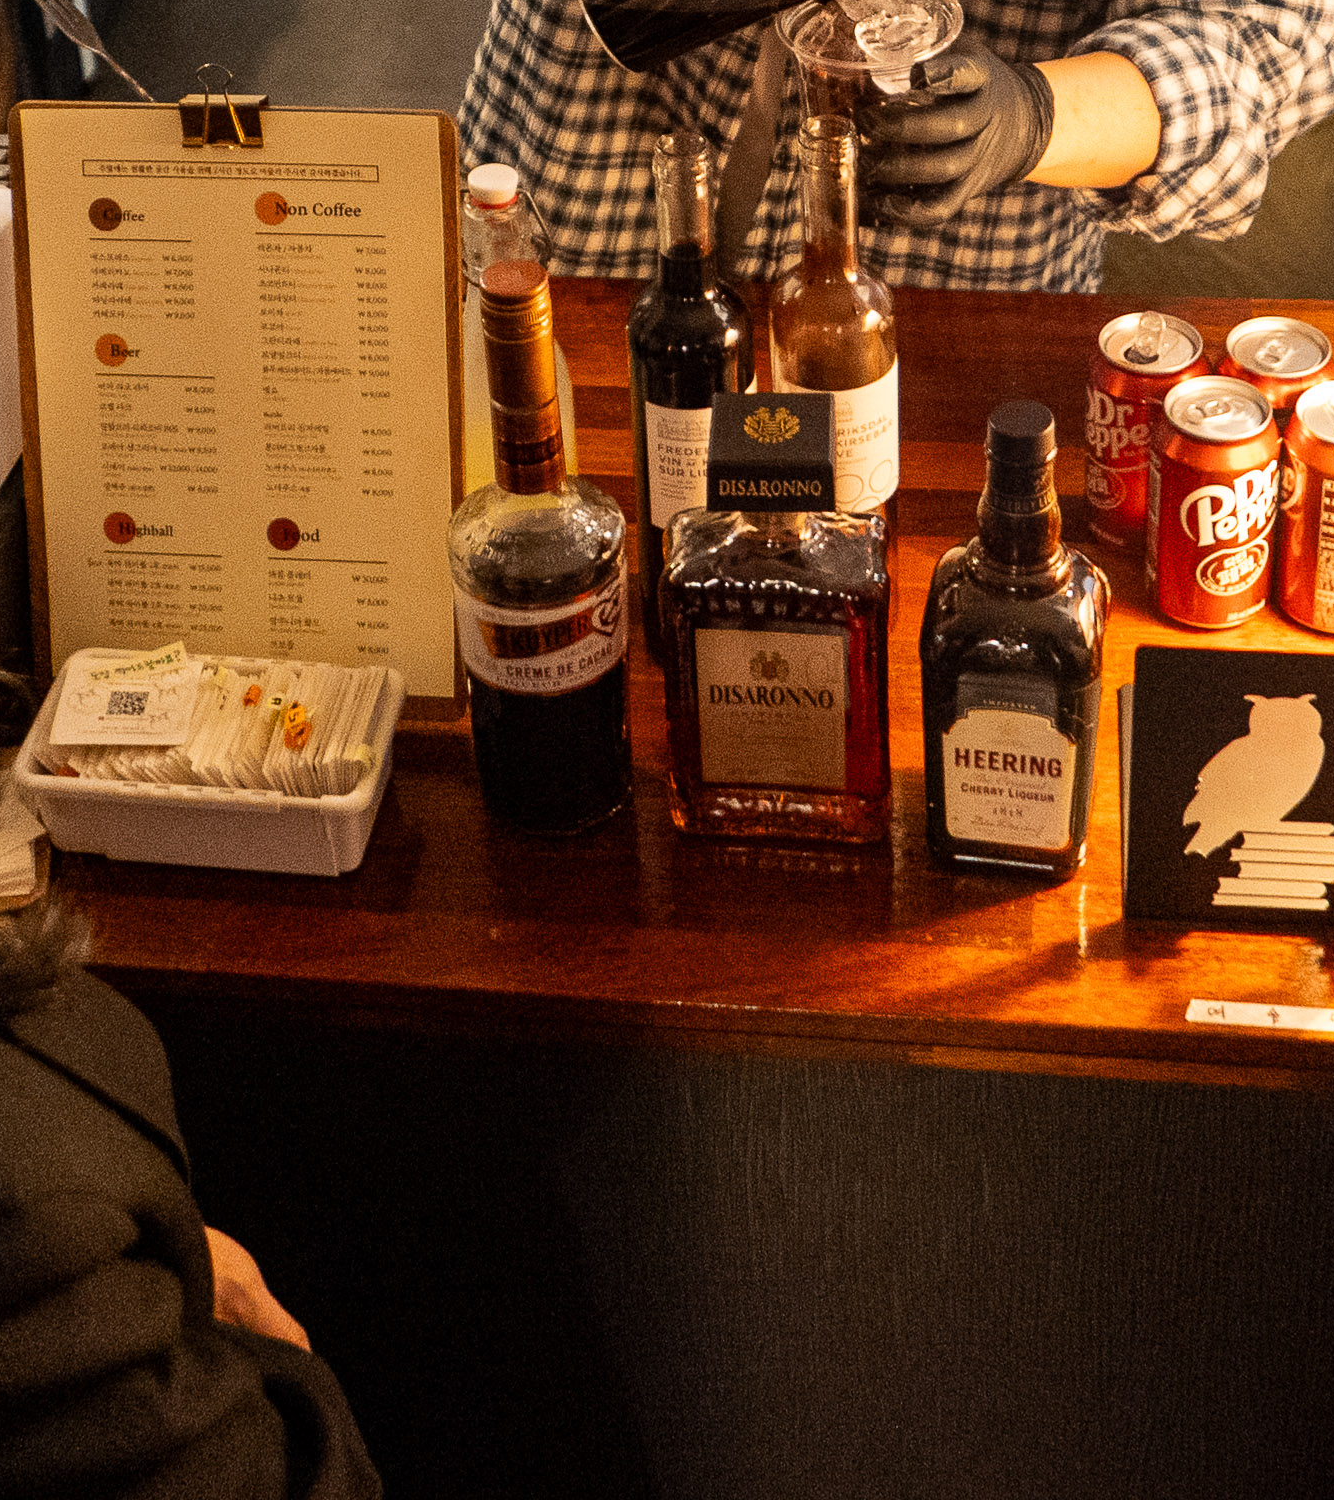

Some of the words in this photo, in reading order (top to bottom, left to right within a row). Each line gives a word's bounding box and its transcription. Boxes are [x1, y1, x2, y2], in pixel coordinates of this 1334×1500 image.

[274, 201, 308, 216] Non
[312, 202, 361, 218] Coffee
[110, 343, 141, 358] Beer
[1094, 390, 1134, 426] Dr
[836, 415, 887, 438] RIKSDAL
[657, 443, 708, 457] FREDE
[659, 456, 681, 467] VIN
[659, 465, 685, 477] SUR
[718, 479, 822, 498] DISARONNO
[1233, 459, 1278, 511] Dr
[556, 660, 574, 676] DE
[709, 684, 834, 710] DISARONNO
[953, 746, 1063, 779] HEERING
[960, 781, 1005, 797] CHERRY
[1008, 787, 1055, 803] LIQUEUR
